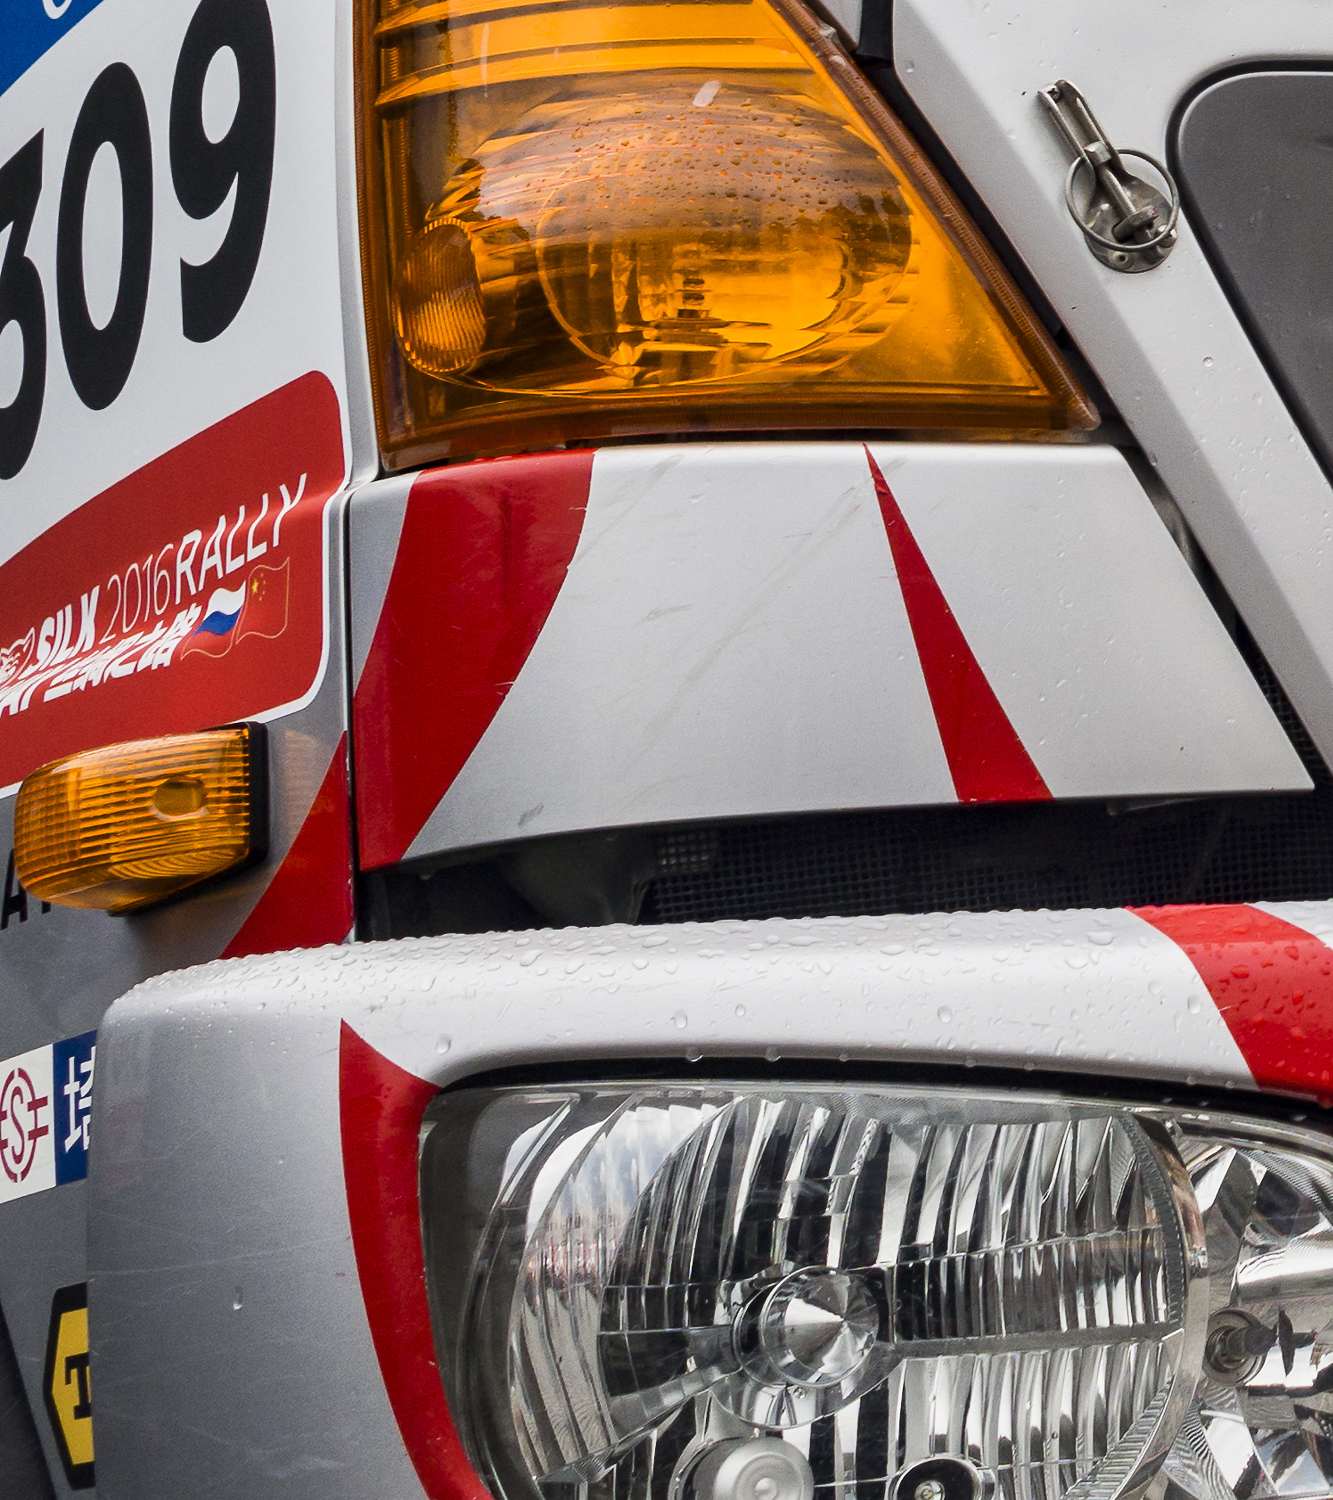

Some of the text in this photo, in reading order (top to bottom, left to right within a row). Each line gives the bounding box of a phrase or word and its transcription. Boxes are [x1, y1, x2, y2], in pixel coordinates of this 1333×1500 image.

[19, 472, 307, 680] SILK 2016 RALLY
